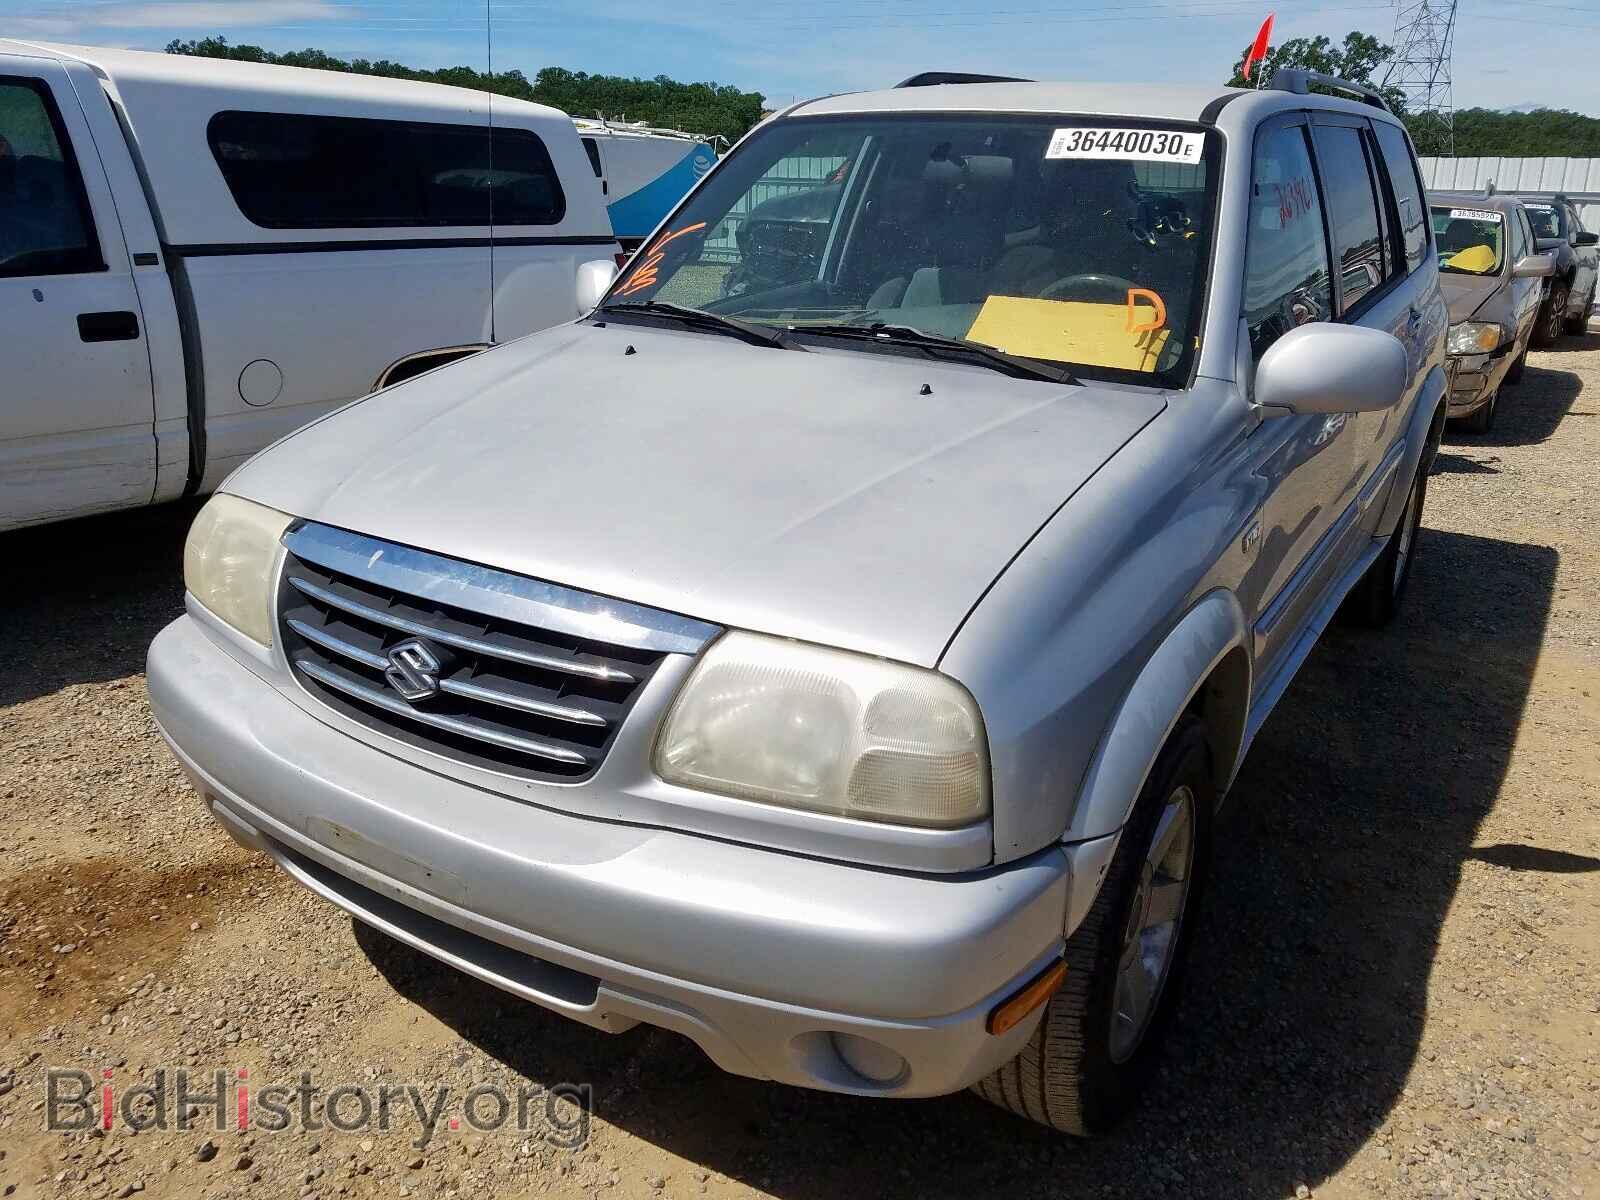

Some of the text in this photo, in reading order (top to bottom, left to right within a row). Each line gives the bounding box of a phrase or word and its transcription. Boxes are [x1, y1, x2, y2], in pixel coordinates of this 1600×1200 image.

[1066, 130, 1184, 156] 36440030
[1183, 144, 1194, 156] E
[1126, 287, 1168, 332] D
